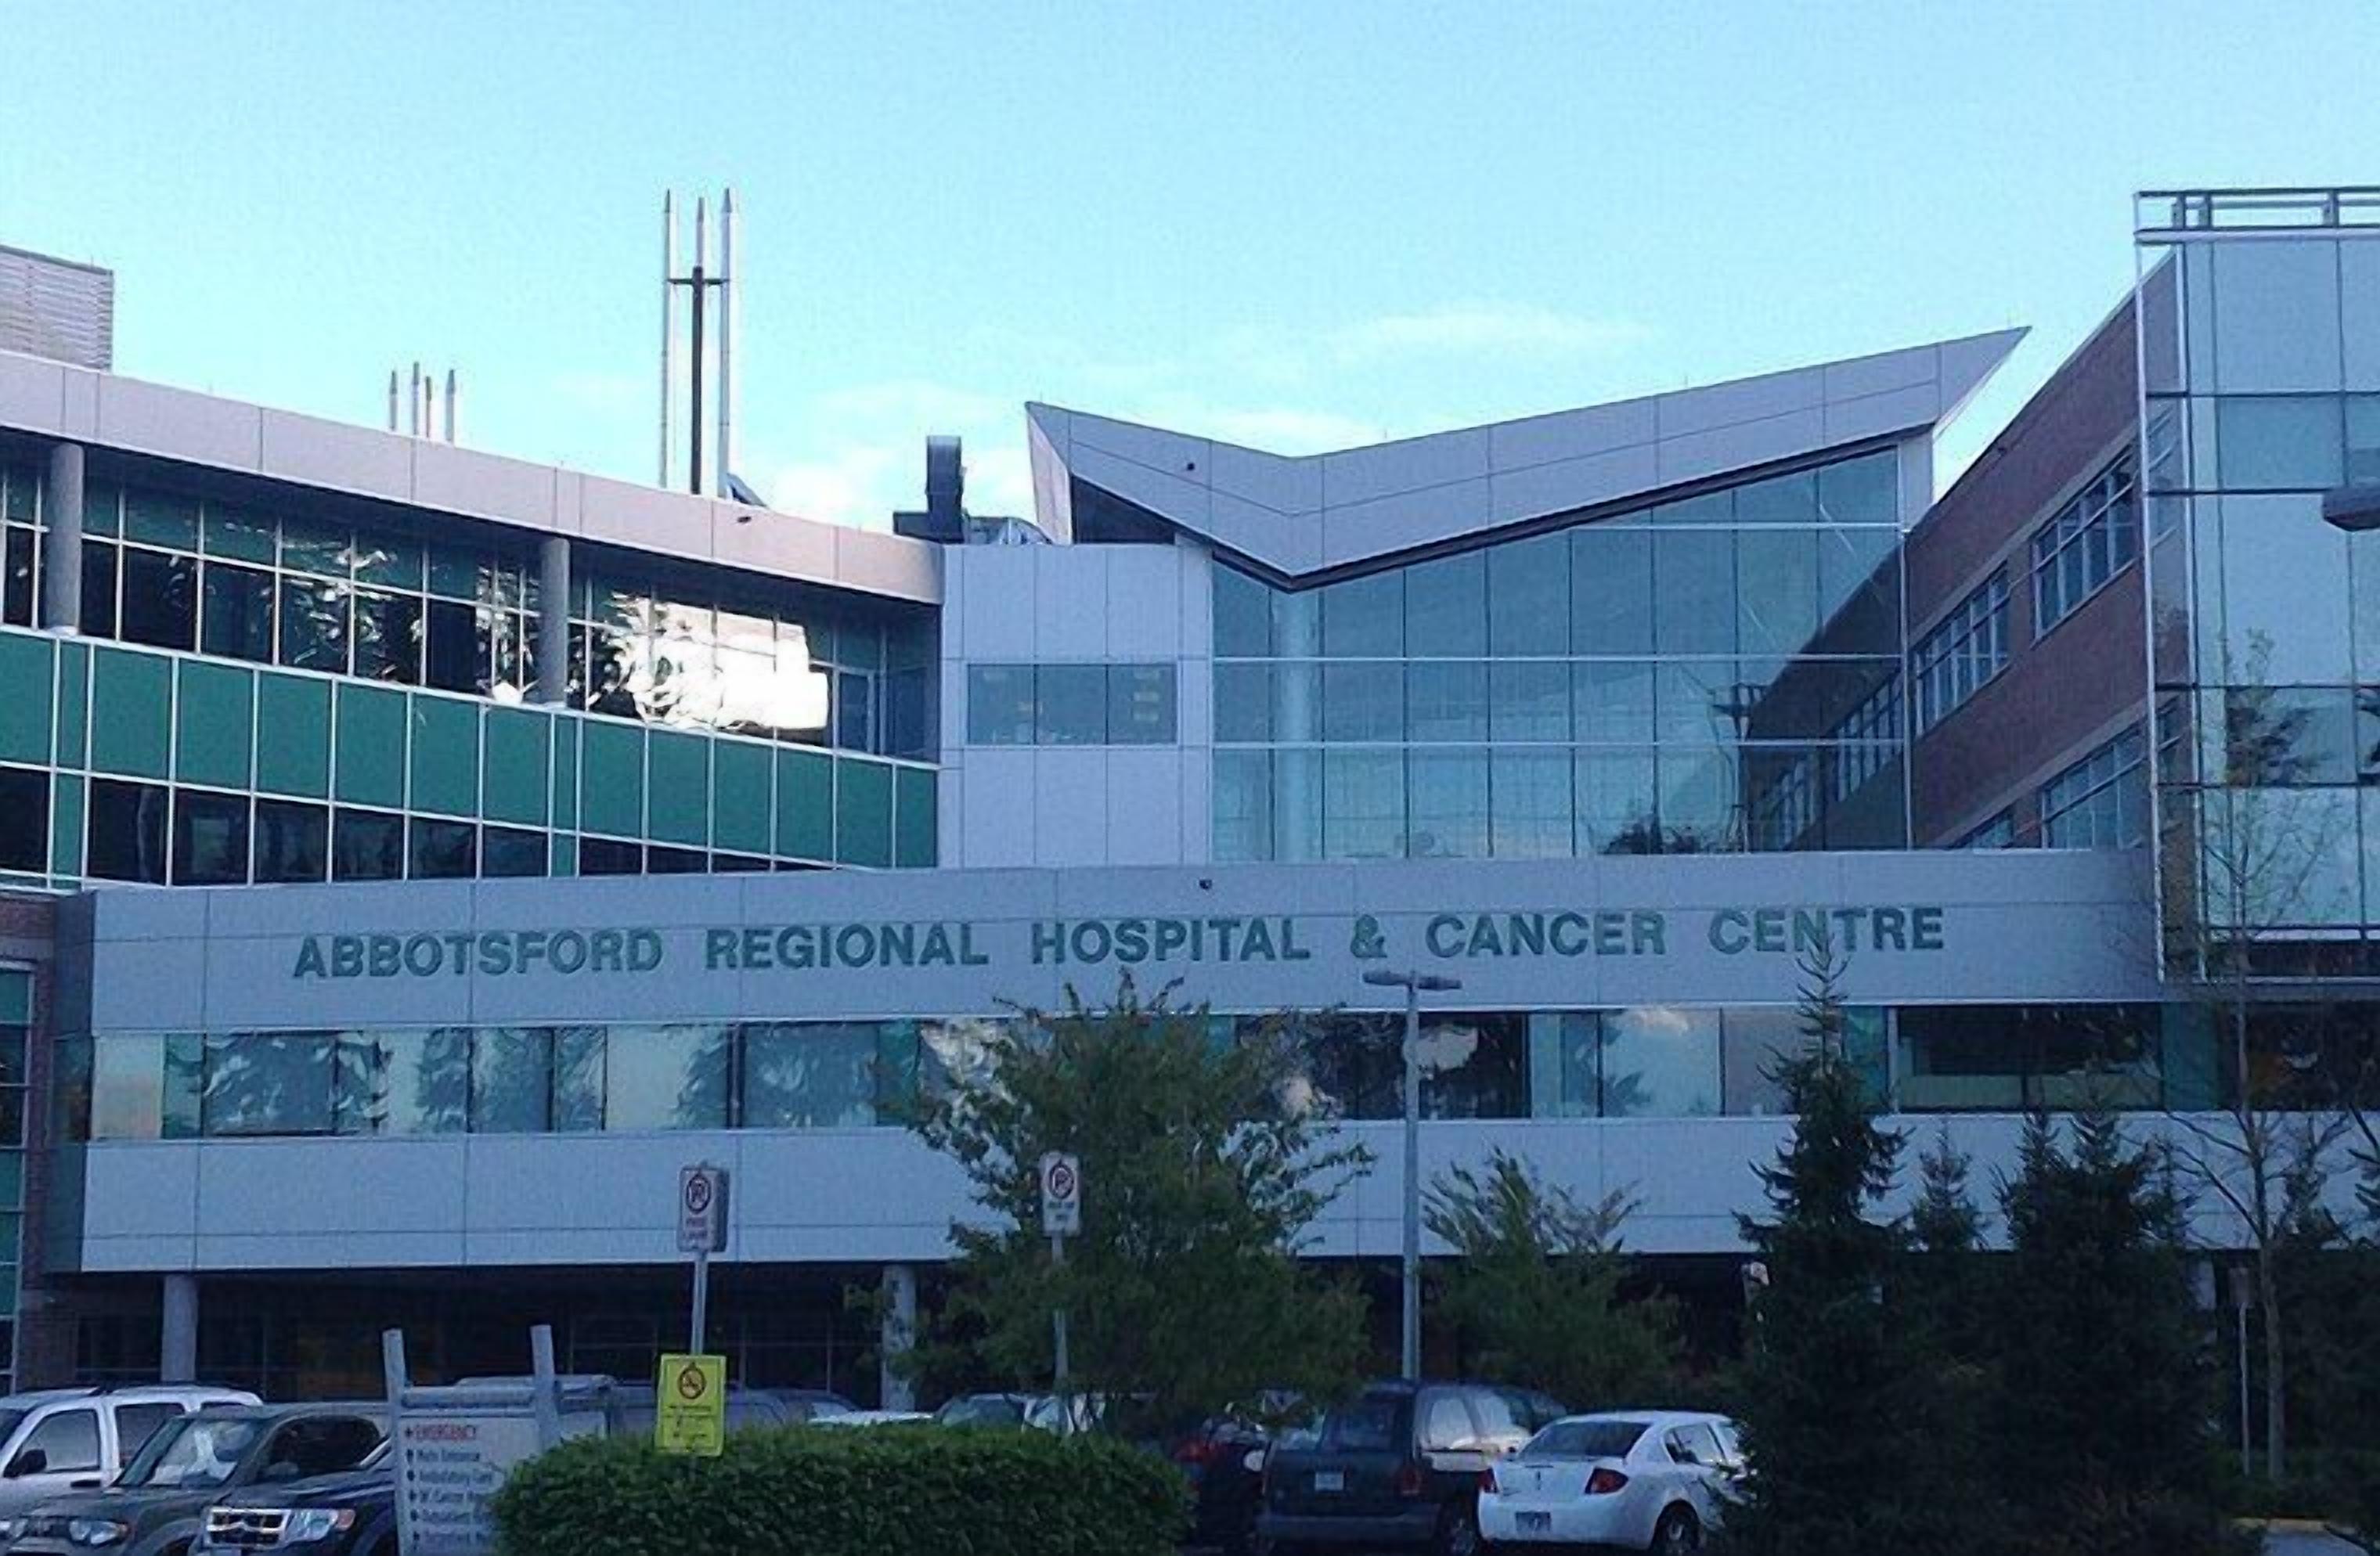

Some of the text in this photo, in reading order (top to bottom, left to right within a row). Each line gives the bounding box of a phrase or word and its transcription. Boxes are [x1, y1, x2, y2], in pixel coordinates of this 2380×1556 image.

[293, 906, 1945, 978] ABBOTSFORD REGIONAL HOSPITAL & CANCER CENTRE
